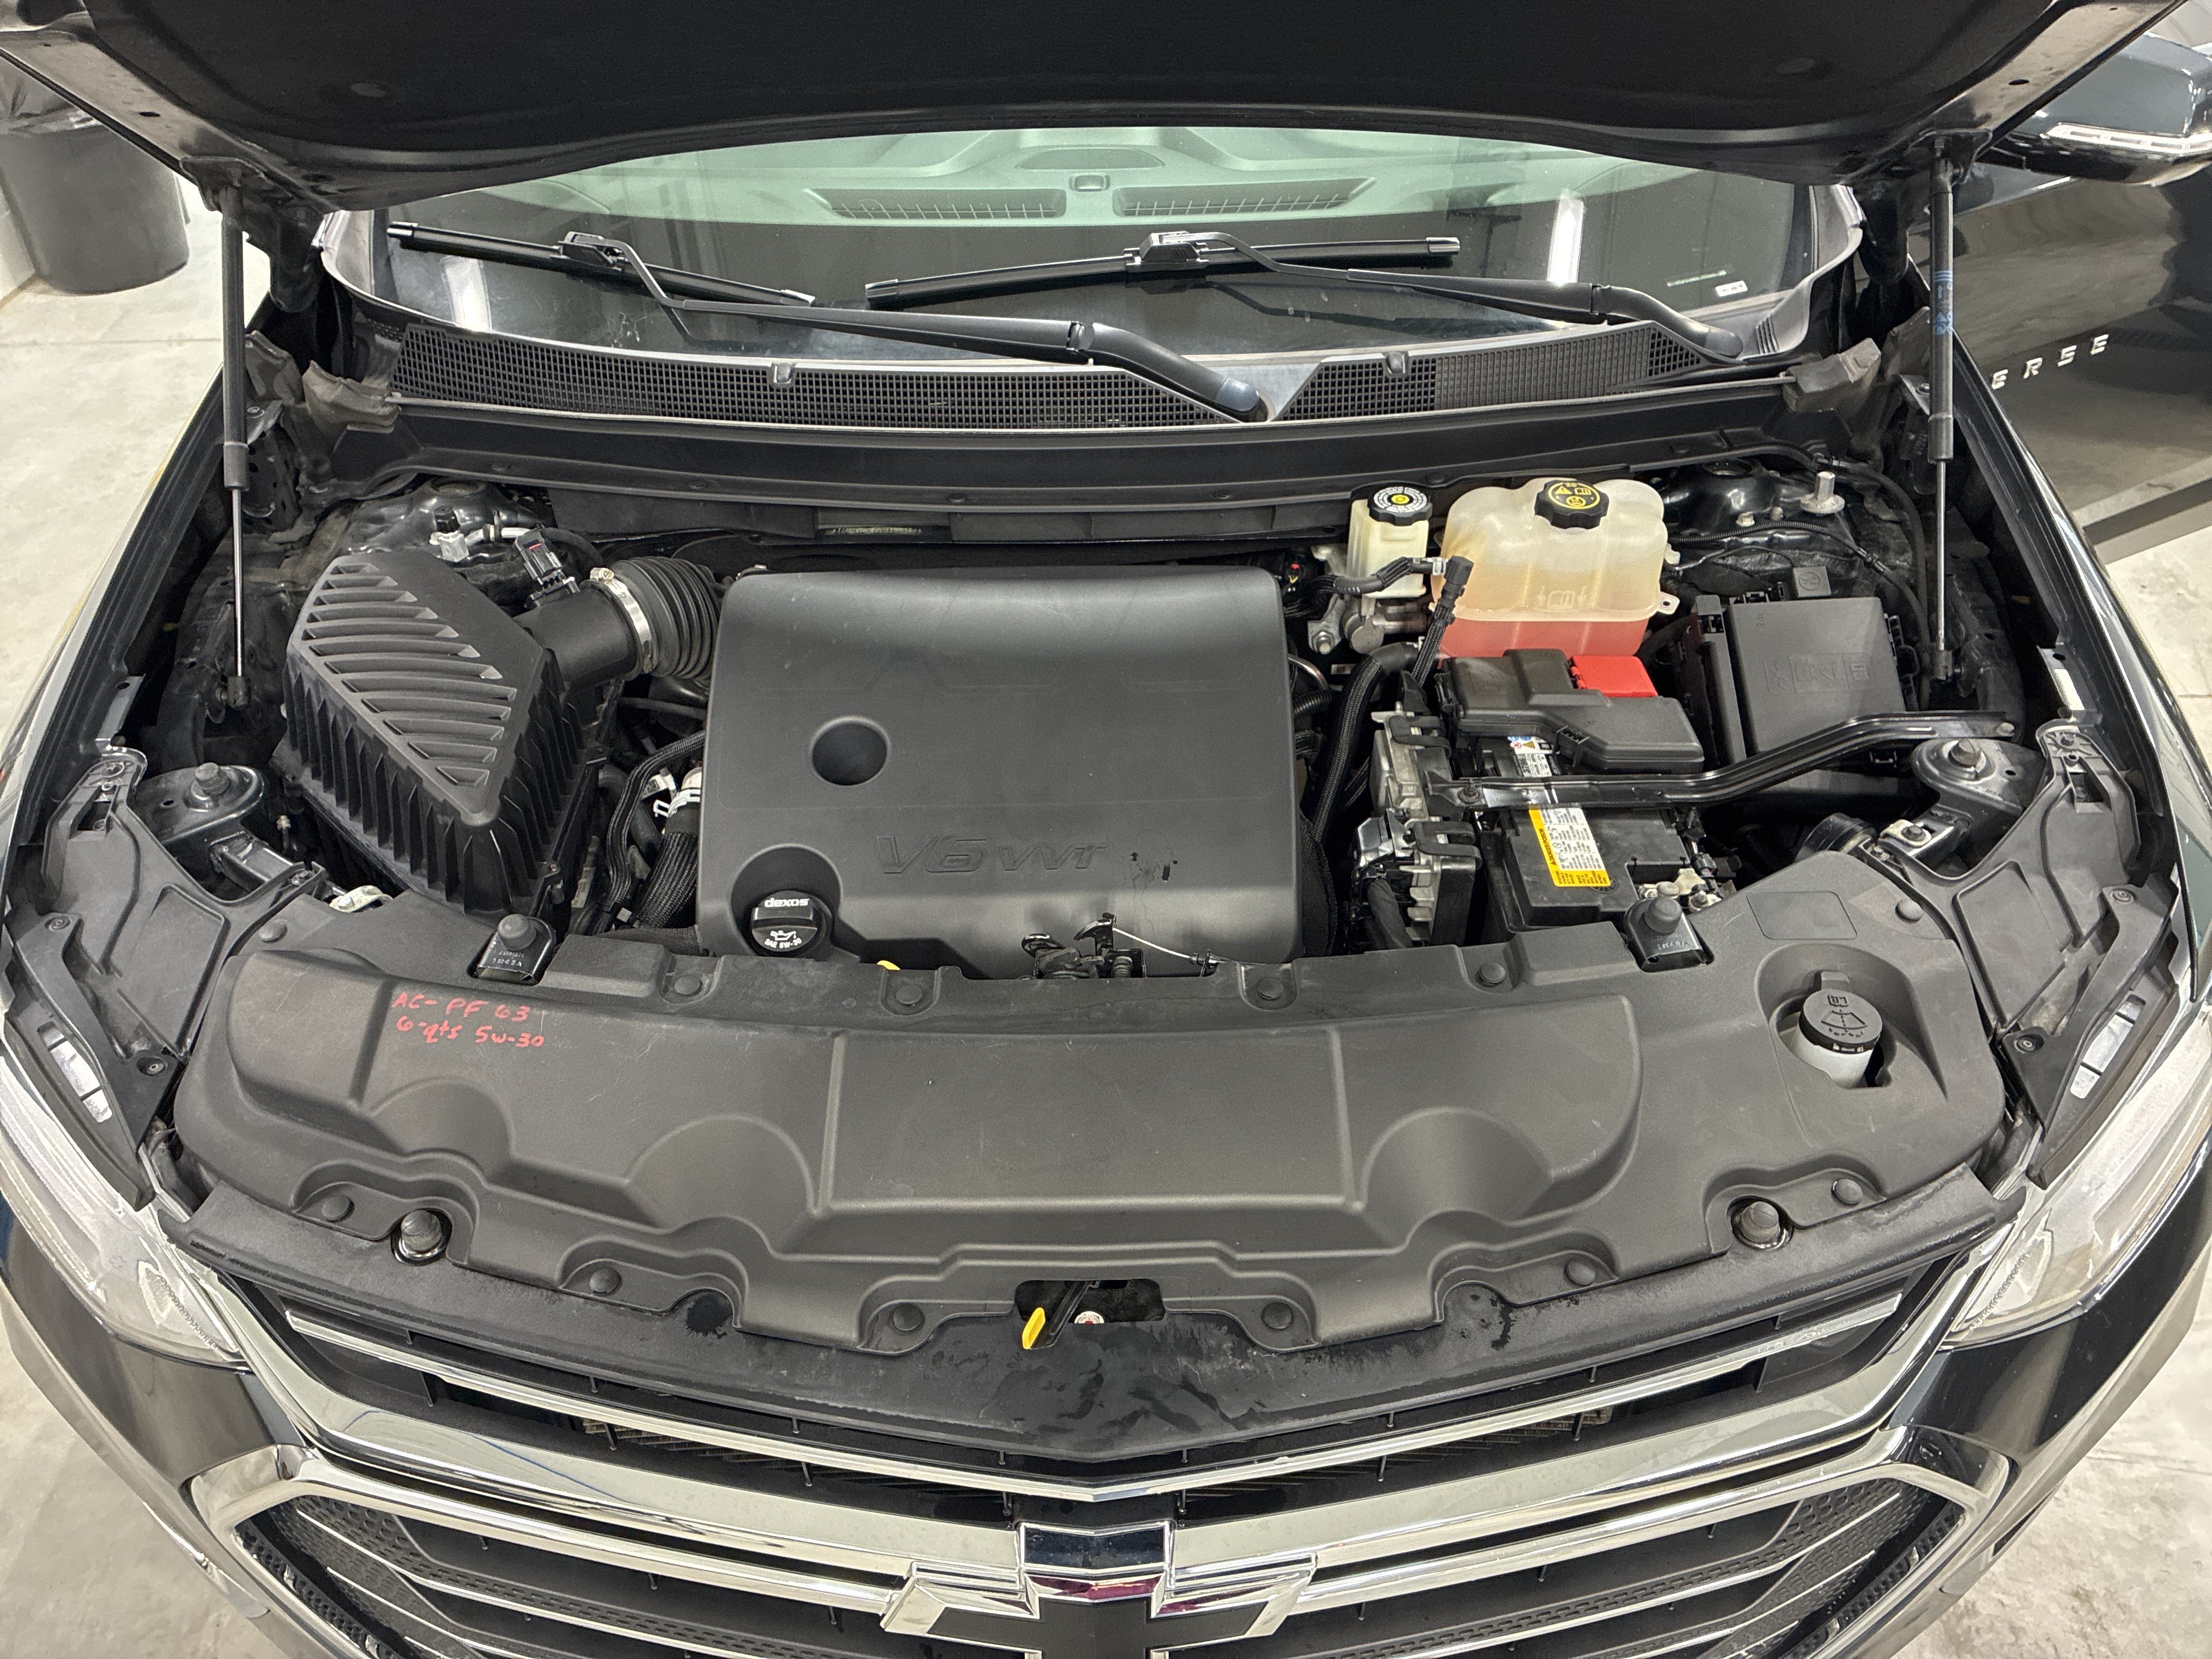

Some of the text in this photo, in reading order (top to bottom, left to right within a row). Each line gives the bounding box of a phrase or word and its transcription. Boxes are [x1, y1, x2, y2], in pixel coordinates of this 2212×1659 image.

[877, 836, 1107, 874] V6 VVT
[764, 897, 810, 907] dexos
[764, 938, 802, 949] SAE 5W-30
[445, 997, 488, 1018] PF
